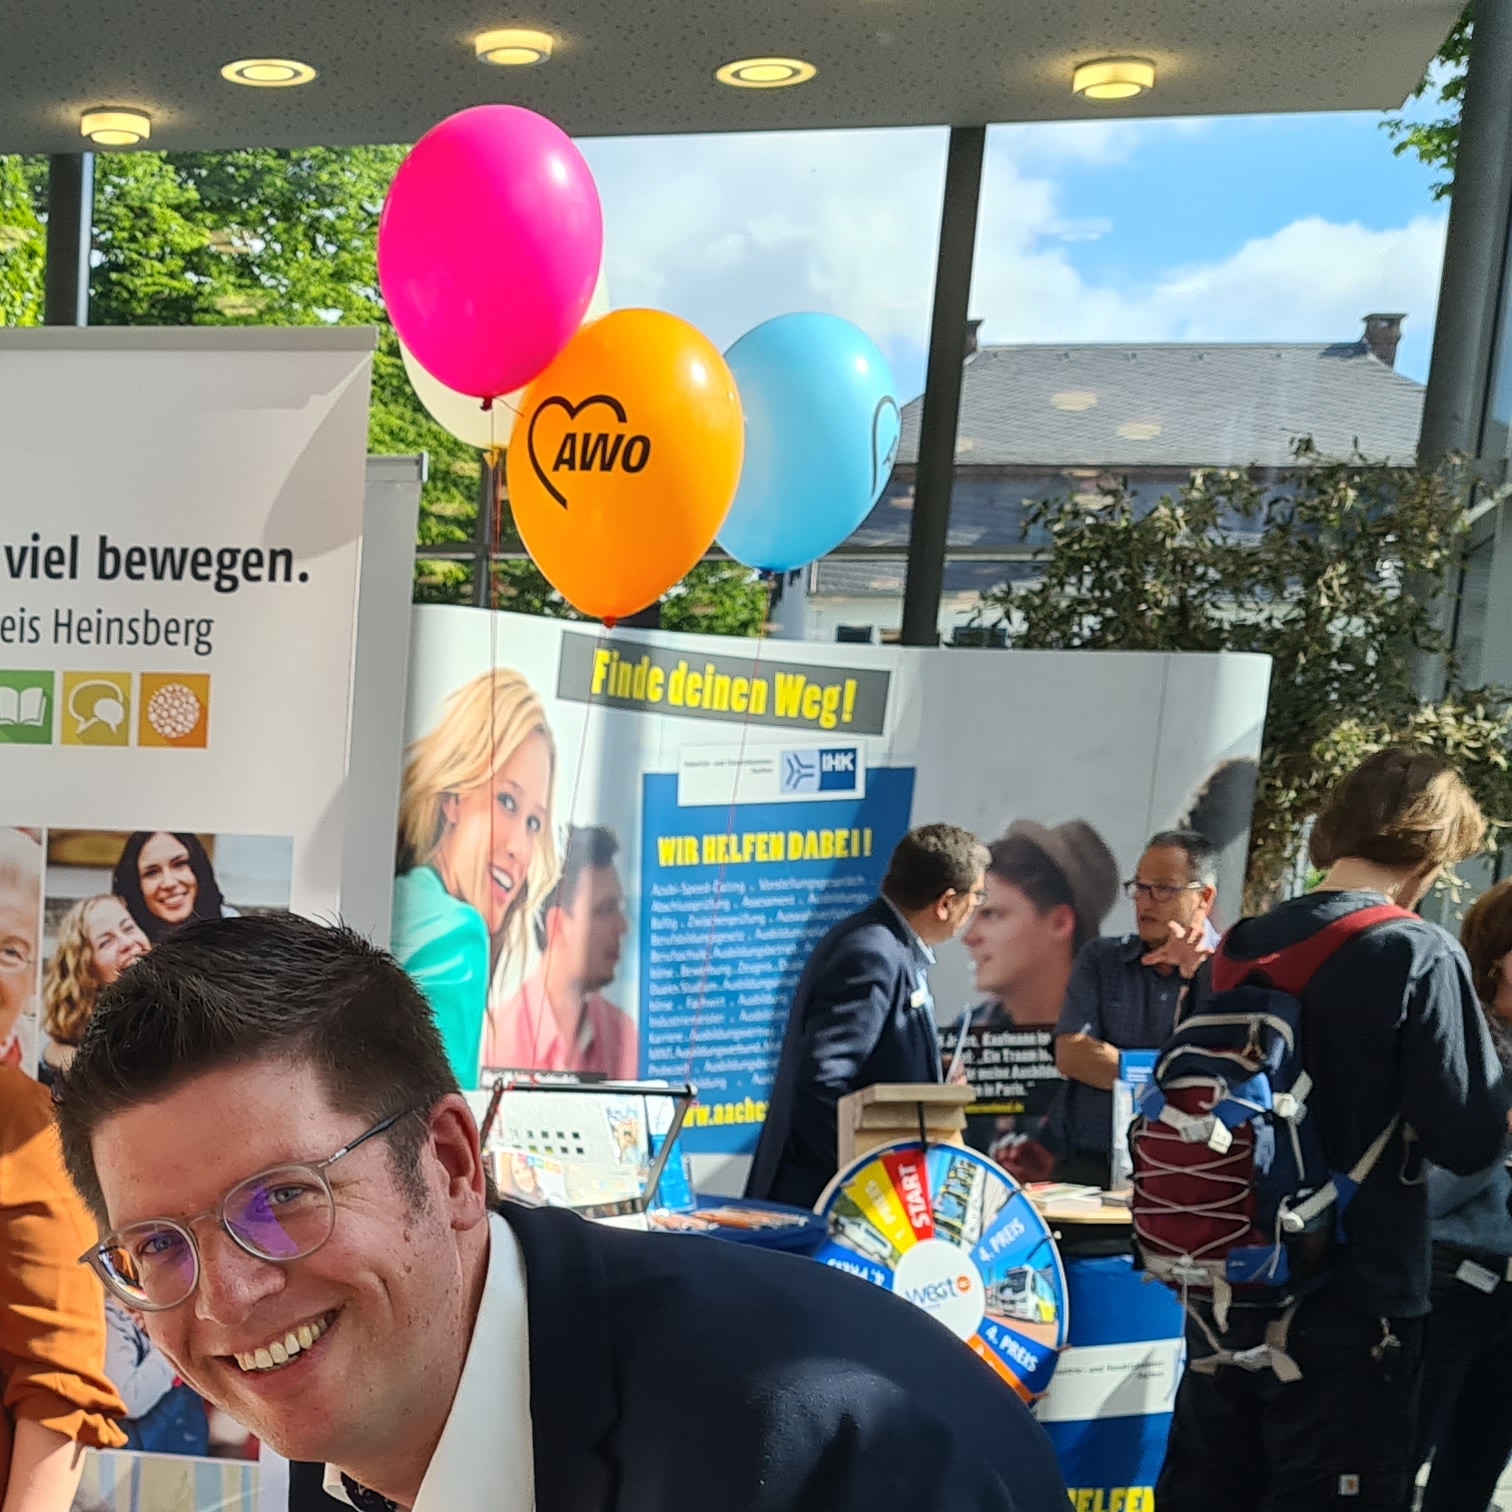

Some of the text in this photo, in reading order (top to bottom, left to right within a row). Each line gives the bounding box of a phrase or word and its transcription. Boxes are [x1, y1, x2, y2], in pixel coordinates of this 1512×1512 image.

[552, 431, 651, 474] AWO
[4, 533, 80, 581] viel
[96, 535, 310, 593] bewegen.
[52, 608, 214, 655] Heinsberg
[591, 647, 858, 730] Finde deinen Weg!
[821, 752, 855, 772] IHK
[657, 836, 700, 867] WIR
[702, 831, 785, 866] HELFEN
[898, 1163, 931, 1229] START
